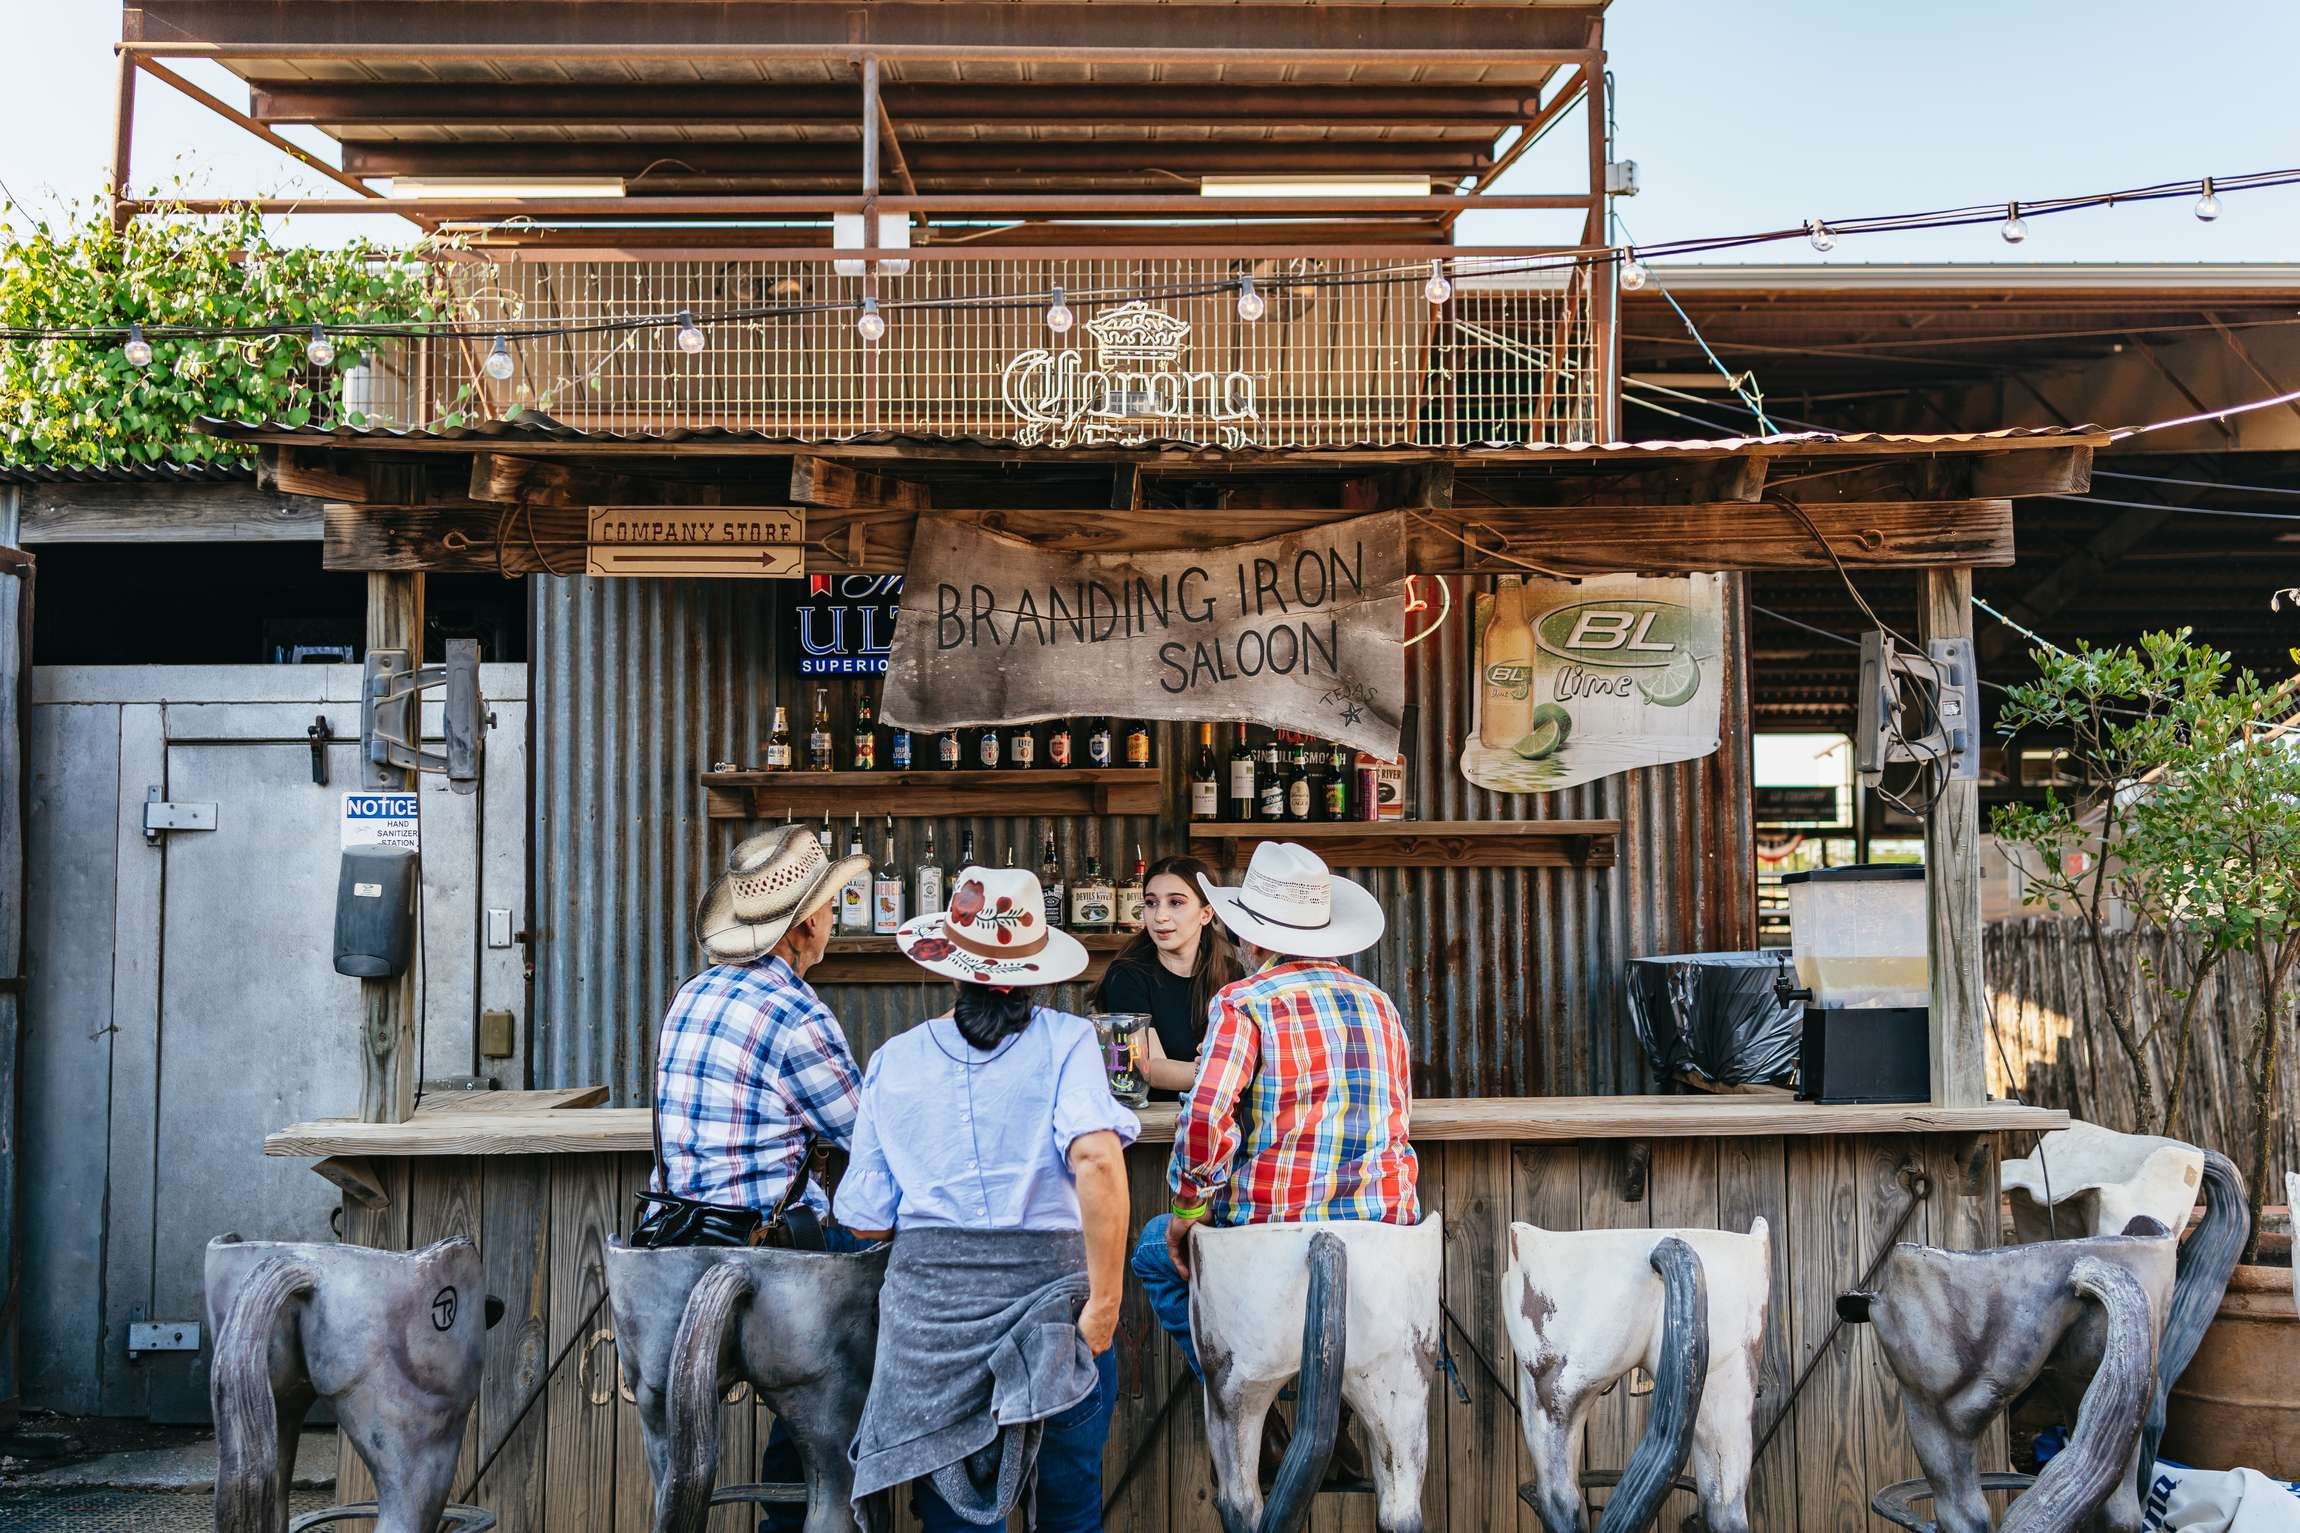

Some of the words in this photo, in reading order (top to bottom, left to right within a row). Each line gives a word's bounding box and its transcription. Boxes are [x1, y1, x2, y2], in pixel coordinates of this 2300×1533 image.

[1003, 349, 1259, 431] Corona
[604, 522, 714, 541] COMPANY
[723, 523, 792, 541] STORE
[937, 566, 1216, 650] BRANDING
[1238, 541, 1363, 616] IRON
[796, 606, 899, 655] UL
[1564, 610, 1676, 651] BL
[802, 659, 889, 672] SUPERIO
[1158, 619, 1338, 694] SALOON
[1319, 683, 1378, 707] TEJAS
[1553, 665, 1633, 702] Lime
[1303, 751, 1346, 765] SMOH
[347, 799, 418, 816] NOTICE
[387, 820, 410, 828] HAND
